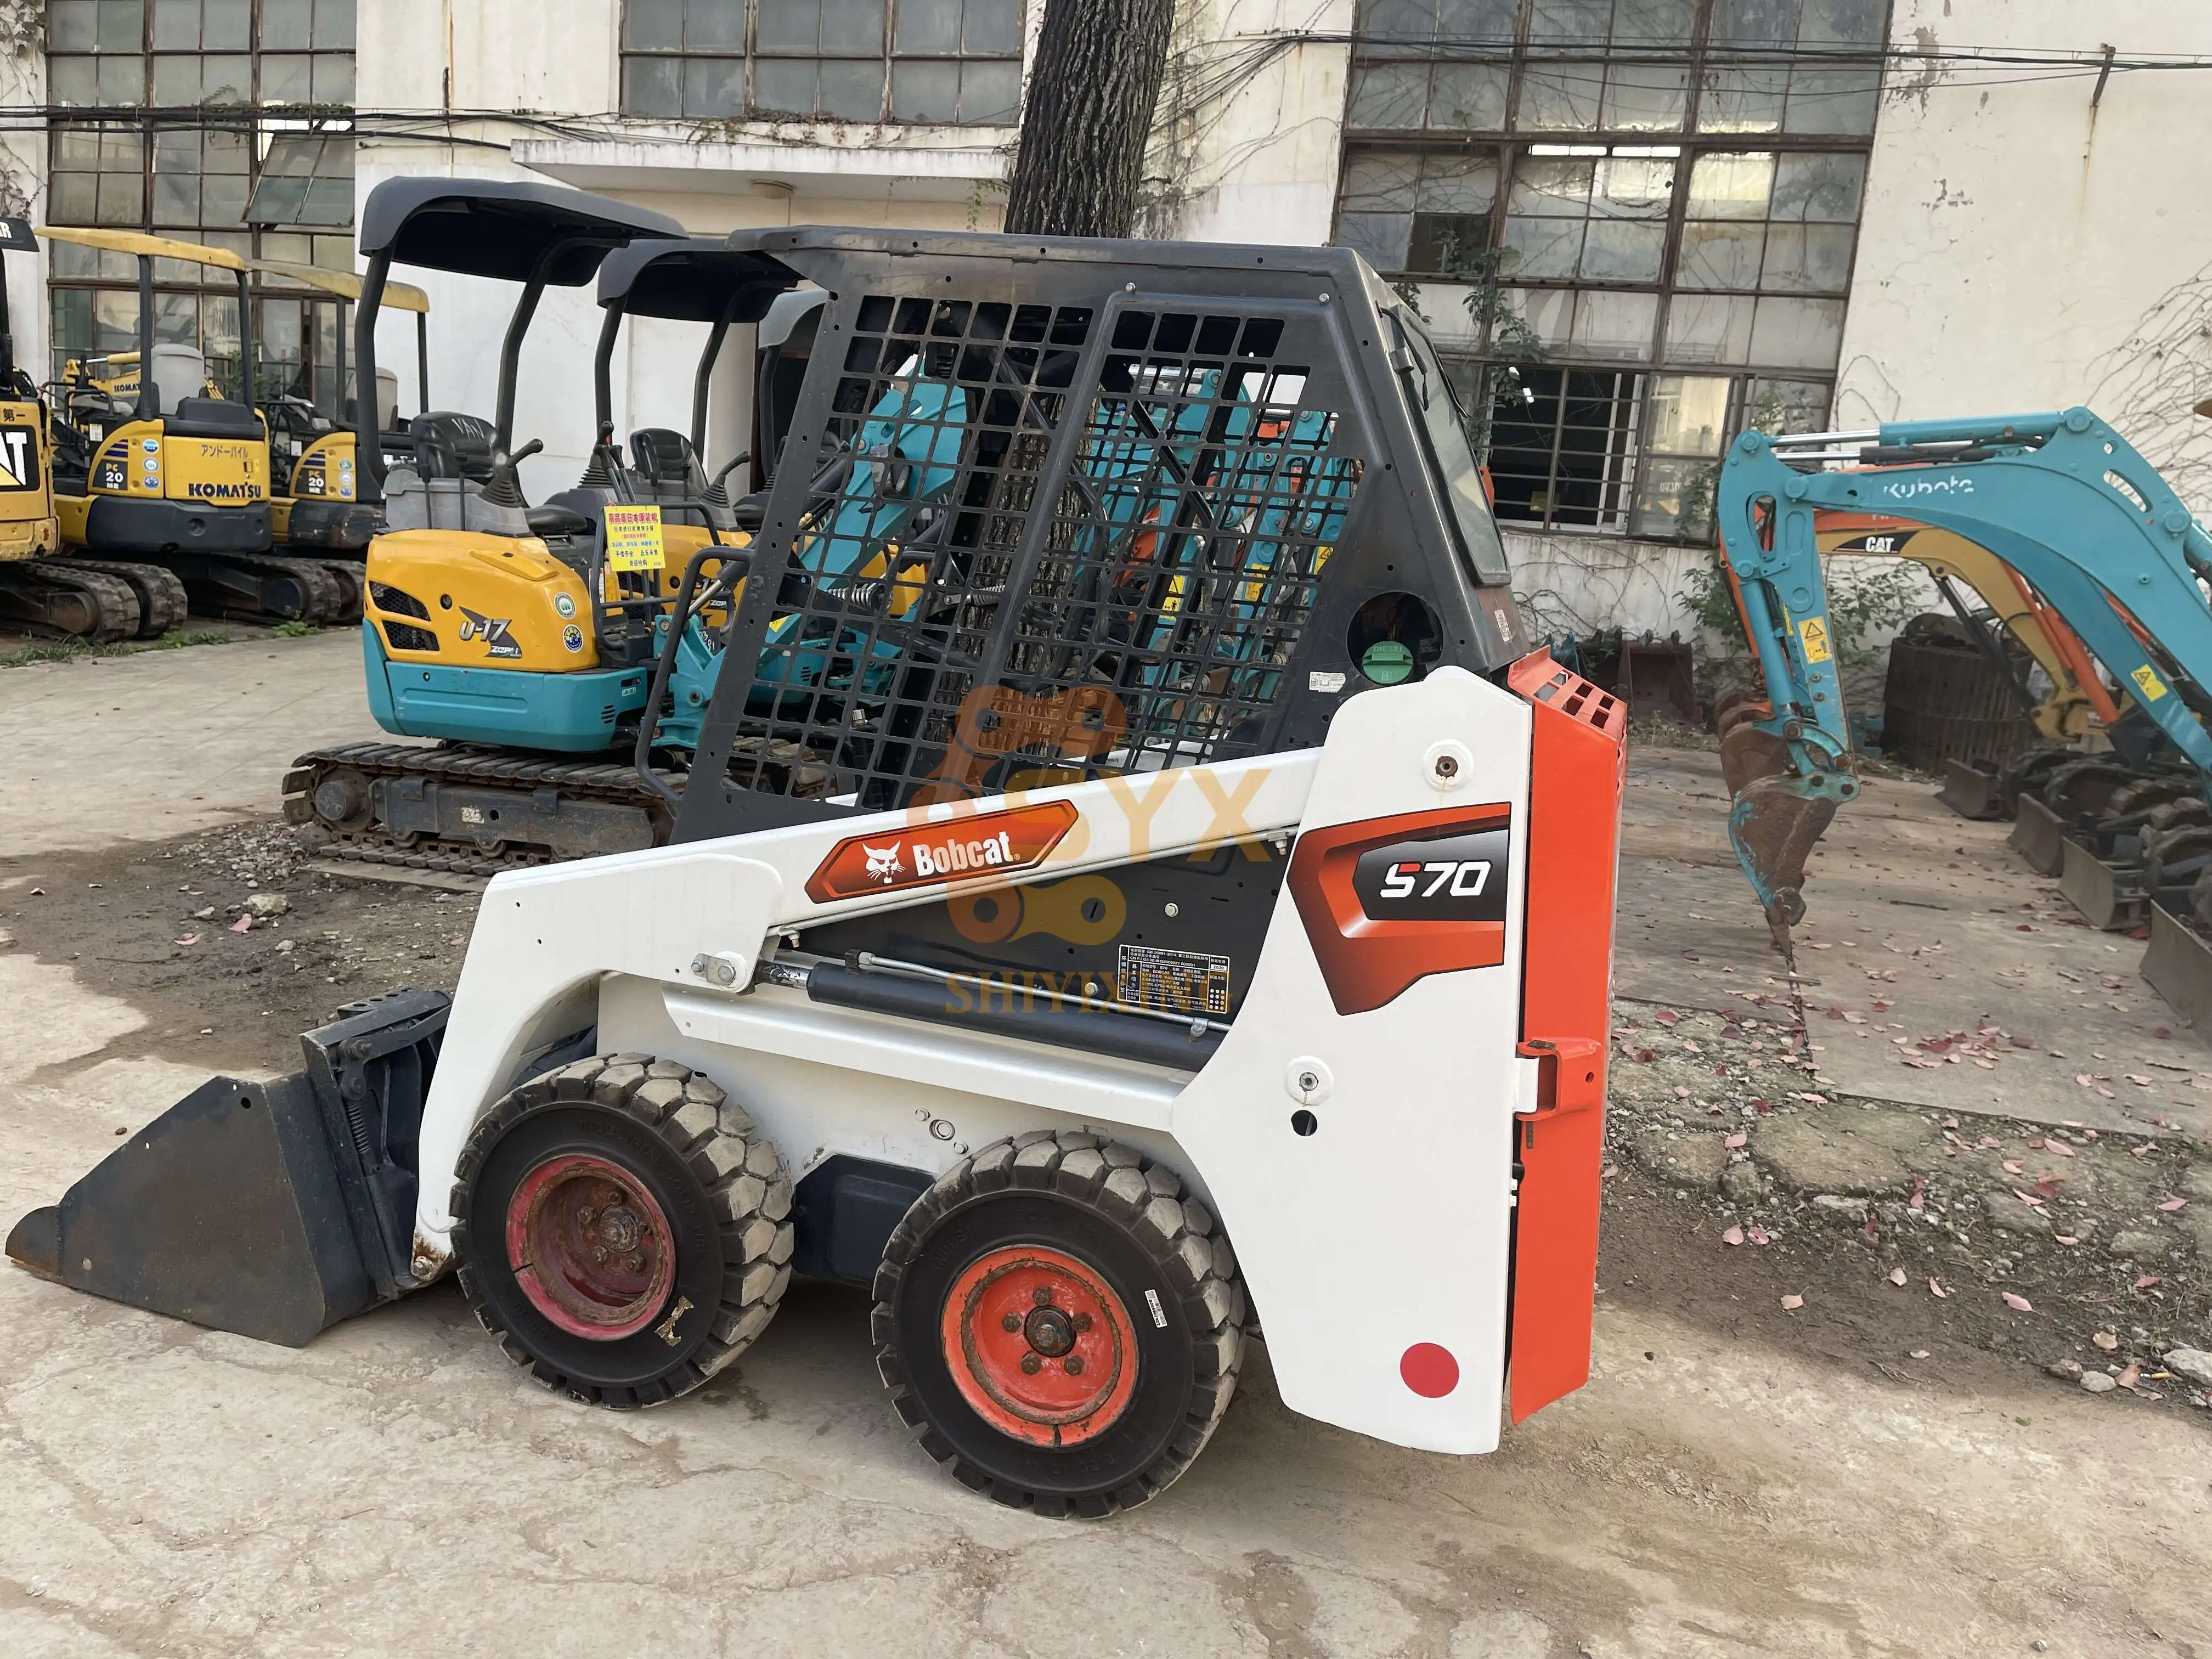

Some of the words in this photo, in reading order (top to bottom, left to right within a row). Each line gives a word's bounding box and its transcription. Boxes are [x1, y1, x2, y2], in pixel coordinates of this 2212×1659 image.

[106, 463, 119, 472] PC
[106, 472, 123, 483] 20
[308, 477, 324, 488] 20
[188, 483, 261, 498] KOMATSU
[1865, 536, 1894, 553] CAT
[459, 618, 512, 641] U-17
[912, 831, 1014, 877] Bobcat
[1380, 861, 1492, 898] S70
